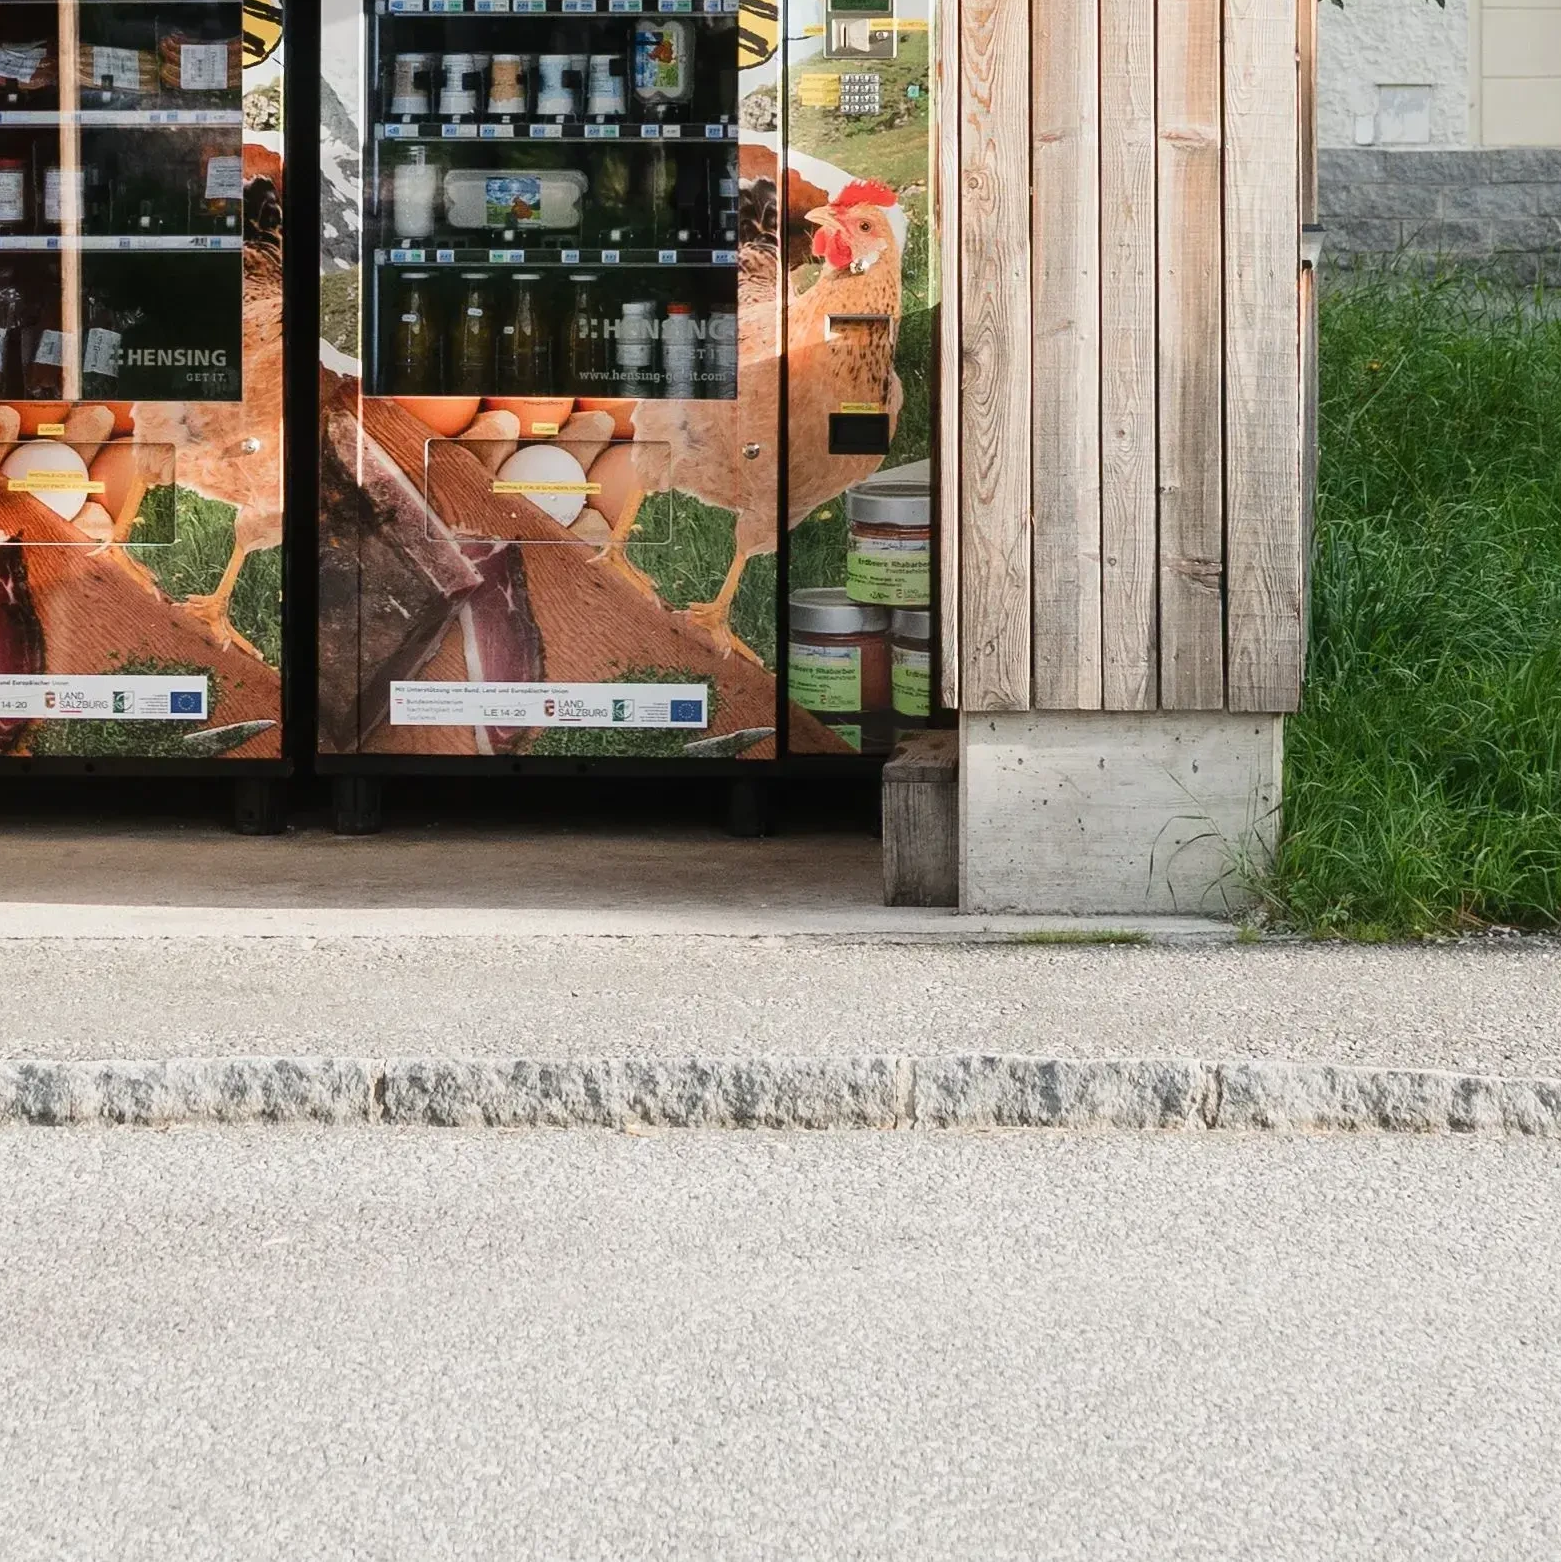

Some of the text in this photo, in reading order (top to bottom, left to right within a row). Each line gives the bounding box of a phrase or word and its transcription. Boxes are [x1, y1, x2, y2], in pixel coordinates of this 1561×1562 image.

[127, 349, 227, 367] HENSING
[186, 373, 209, 382] GET
[59, 692, 84, 700] LAND
[59, 700, 108, 709] SALZBURG
[558, 700, 584, 708] LAND
[484, 709, 499, 717] LE
[558, 709, 608, 717] SALZBURG
